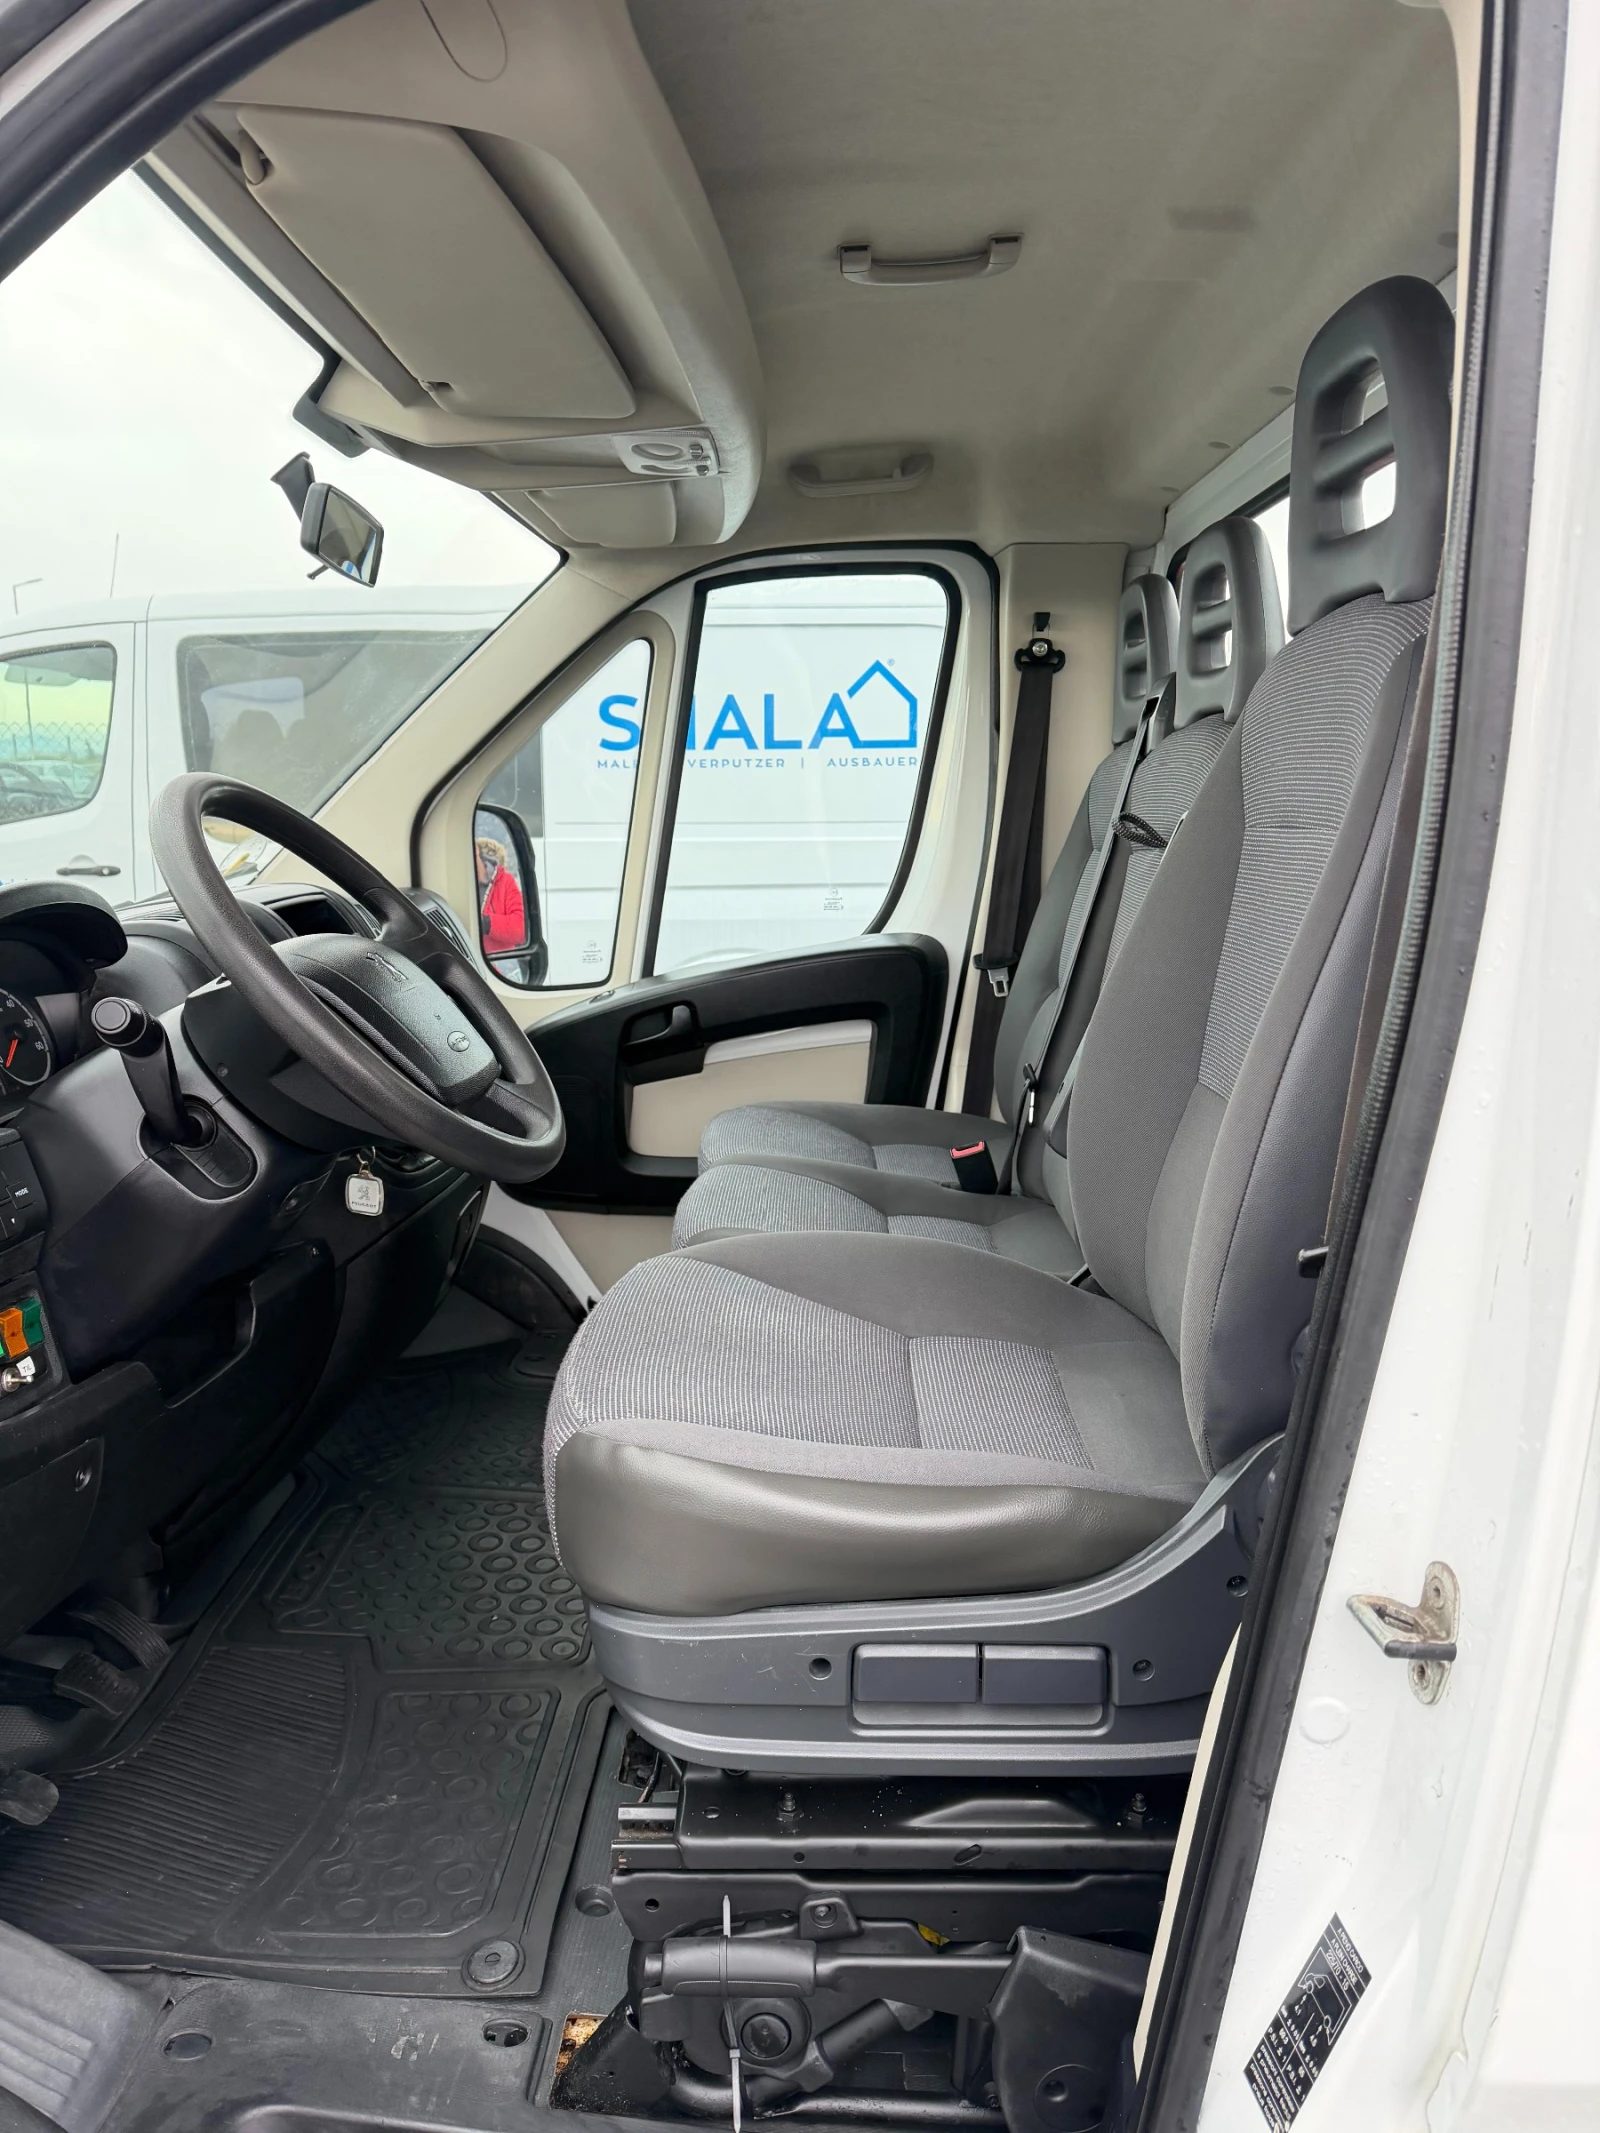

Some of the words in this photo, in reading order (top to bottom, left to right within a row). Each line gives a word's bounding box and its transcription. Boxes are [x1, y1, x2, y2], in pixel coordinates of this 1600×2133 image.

[597, 759, 637, 769] MAL
[687, 759, 785, 769] VERPUTZER
[827, 757, 917, 768] AUSBAUER
[24, 1018, 34, 1028] 50
[14, 1187, 29, 1197] MODE
[1326, 1949, 1341, 1975] 225/70
